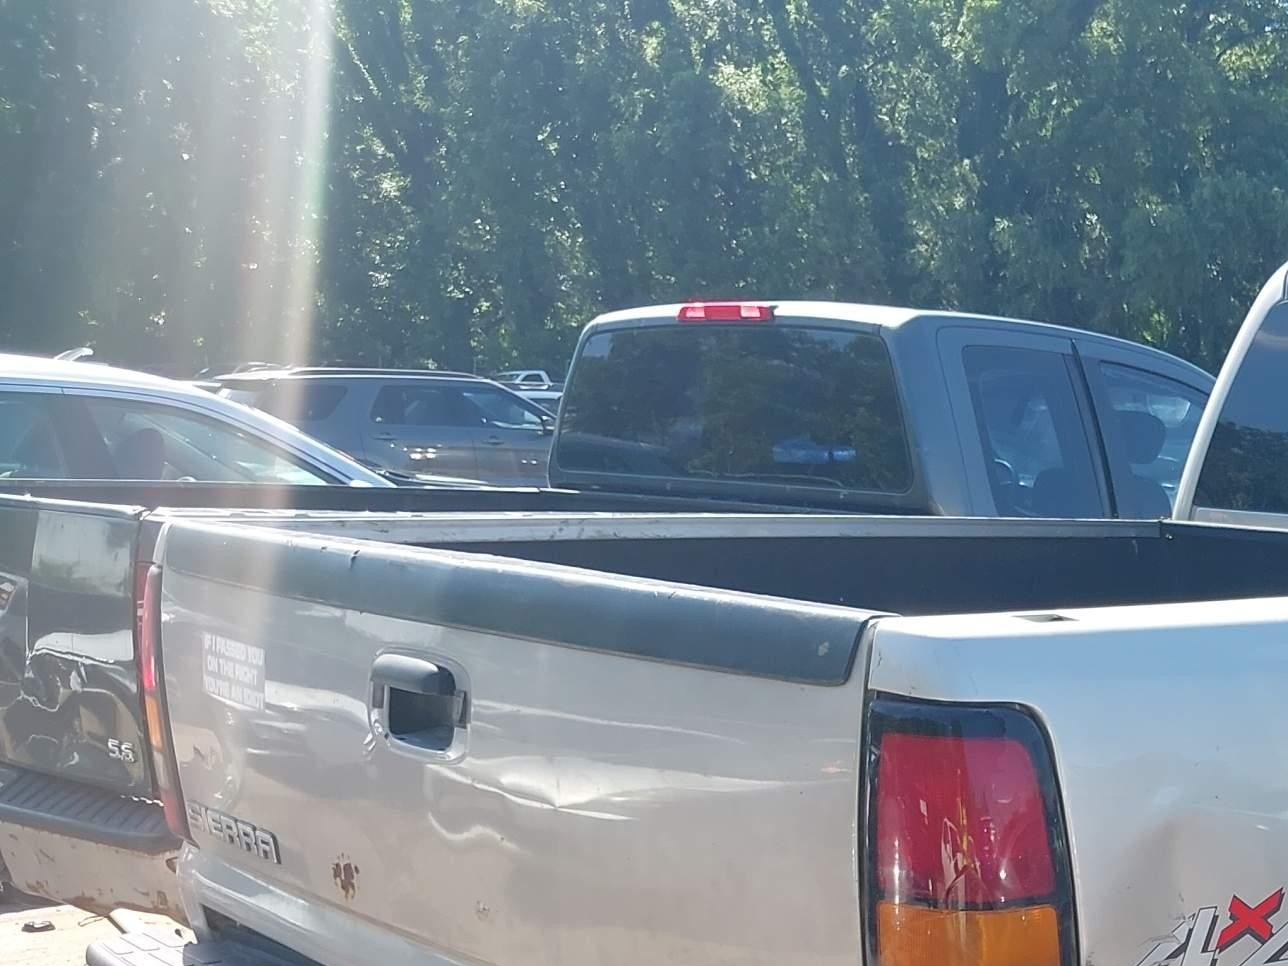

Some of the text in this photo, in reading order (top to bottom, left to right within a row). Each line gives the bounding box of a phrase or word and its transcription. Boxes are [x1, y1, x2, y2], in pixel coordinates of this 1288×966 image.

[207, 655, 218, 673] ON
[247, 645, 265, 667] YOU
[187, 802, 281, 865] SIERRA
